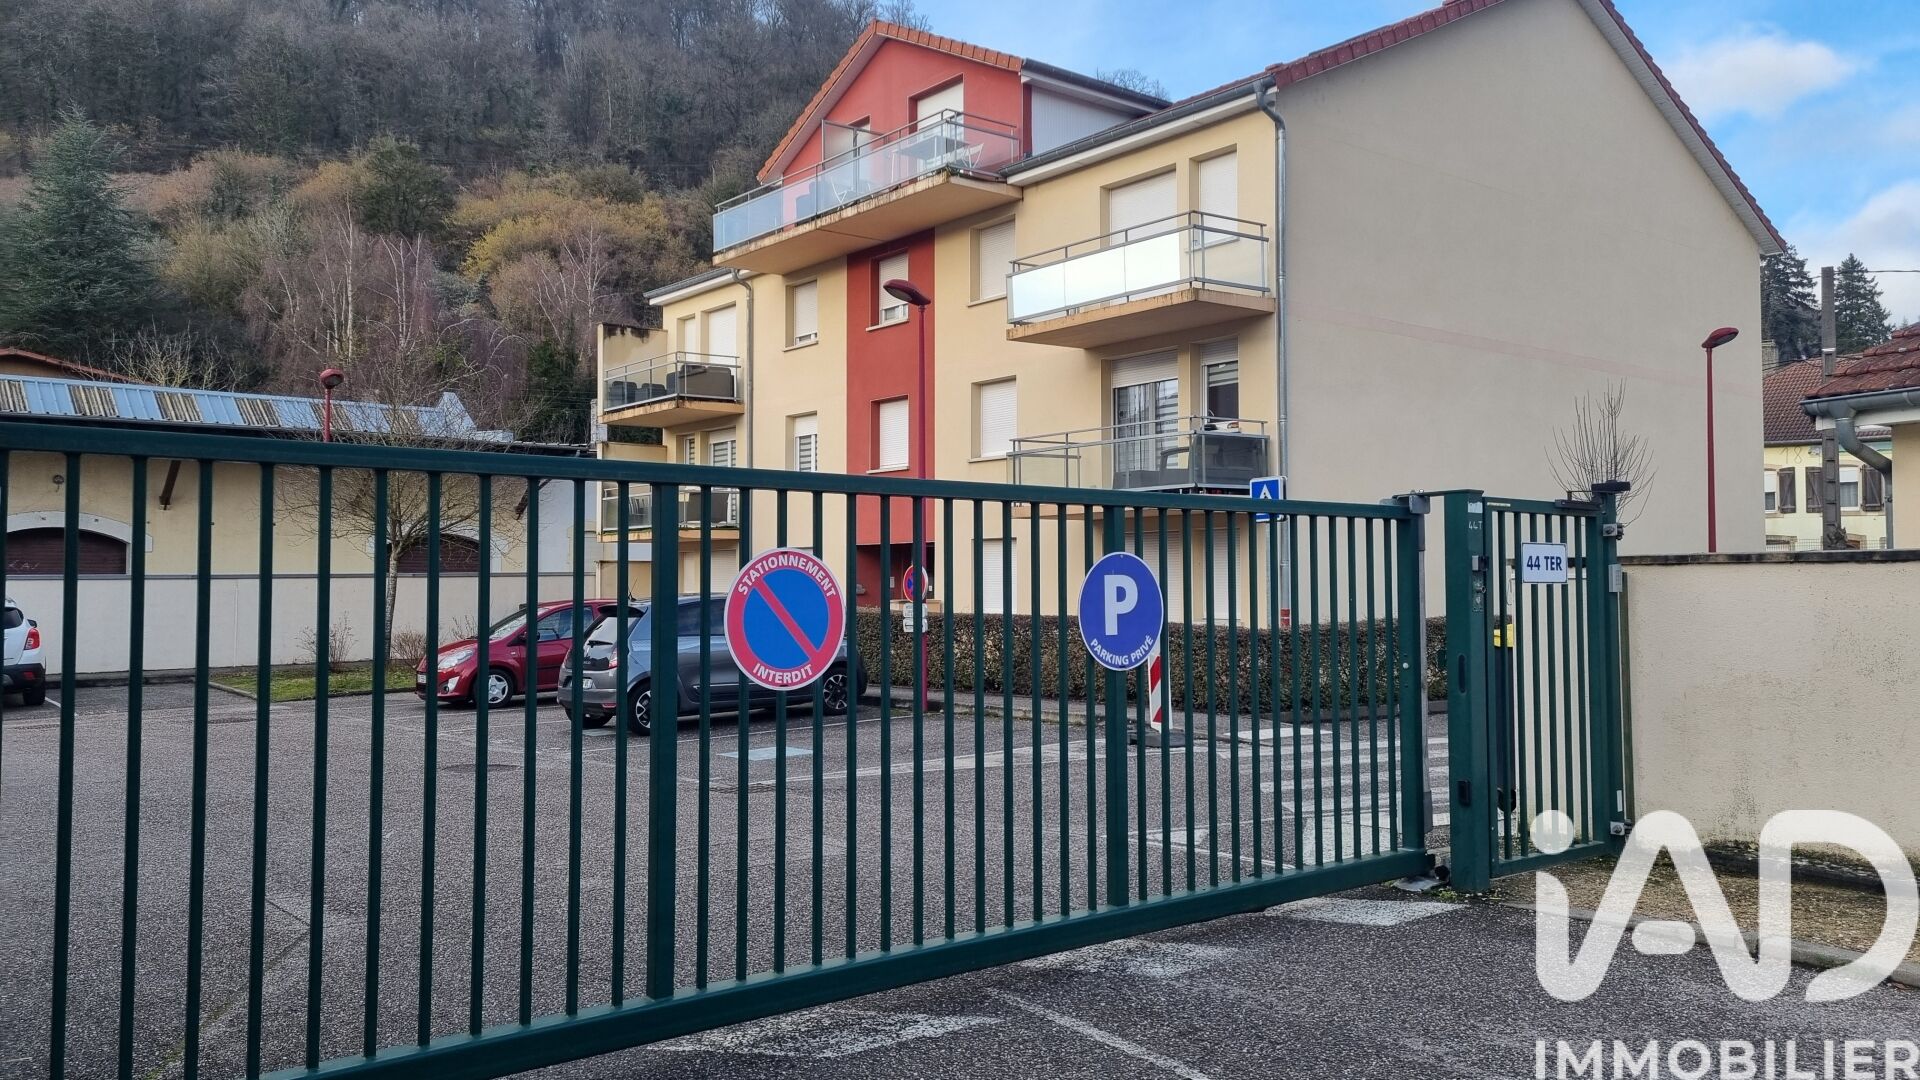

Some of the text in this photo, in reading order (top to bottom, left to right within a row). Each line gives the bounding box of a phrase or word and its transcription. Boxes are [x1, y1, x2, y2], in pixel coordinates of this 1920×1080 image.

[1778, 446, 1802, 464] 18
[738, 554, 836, 597] STATIONNEMENT
[1526, 556, 1562, 571] 44 TER
[1104, 574, 1138, 636] P
[1090, 638, 1129, 666] PARKING
[753, 662, 812, 684] INTERDIT
